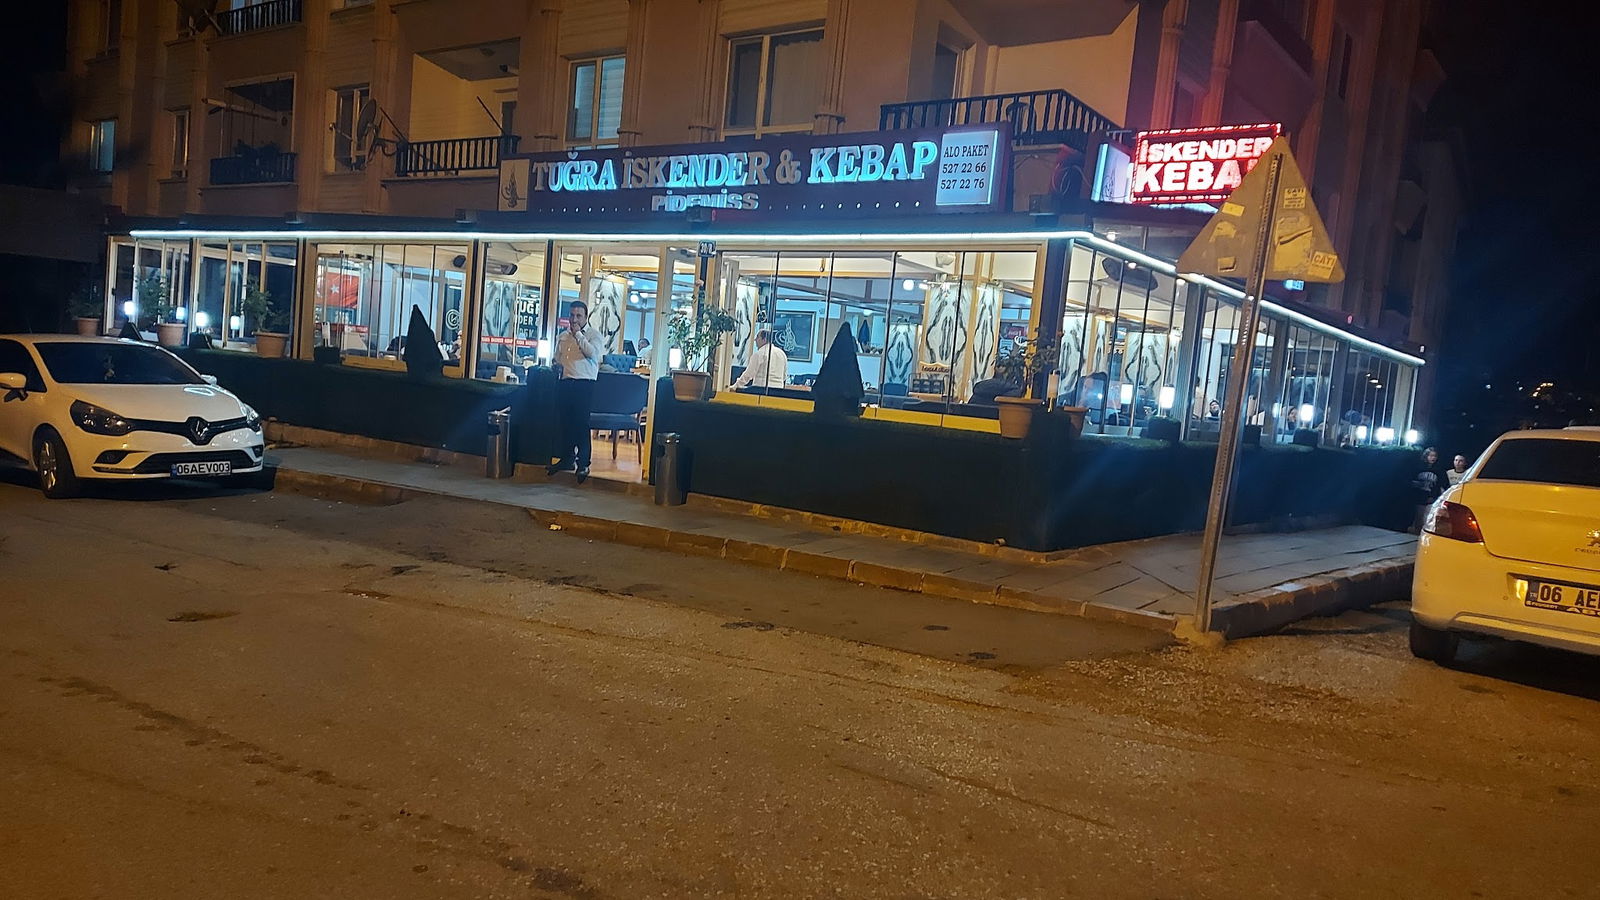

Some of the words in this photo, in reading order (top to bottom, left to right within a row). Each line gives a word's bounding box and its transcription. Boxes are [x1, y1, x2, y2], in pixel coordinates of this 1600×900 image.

[943, 146, 960, 158] ALO
[961, 145, 989, 157] PAKET
[532, 151, 617, 192] TUĞRA
[621, 150, 771, 189] İSKENDER
[775, 149, 801, 185] &
[807, 141, 938, 185] KEBAP
[942, 163, 959, 174] 527
[961, 162, 973, 173] 22
[975, 162, 987, 173] 66
[940, 179, 957, 190] 527
[959, 179, 971, 189] 22
[973, 178, 985, 189] 76
[177, 463, 230, 475] 06AEV003
[1540, 584, 1562, 603] 06
[1575, 590, 1600, 609] AE
